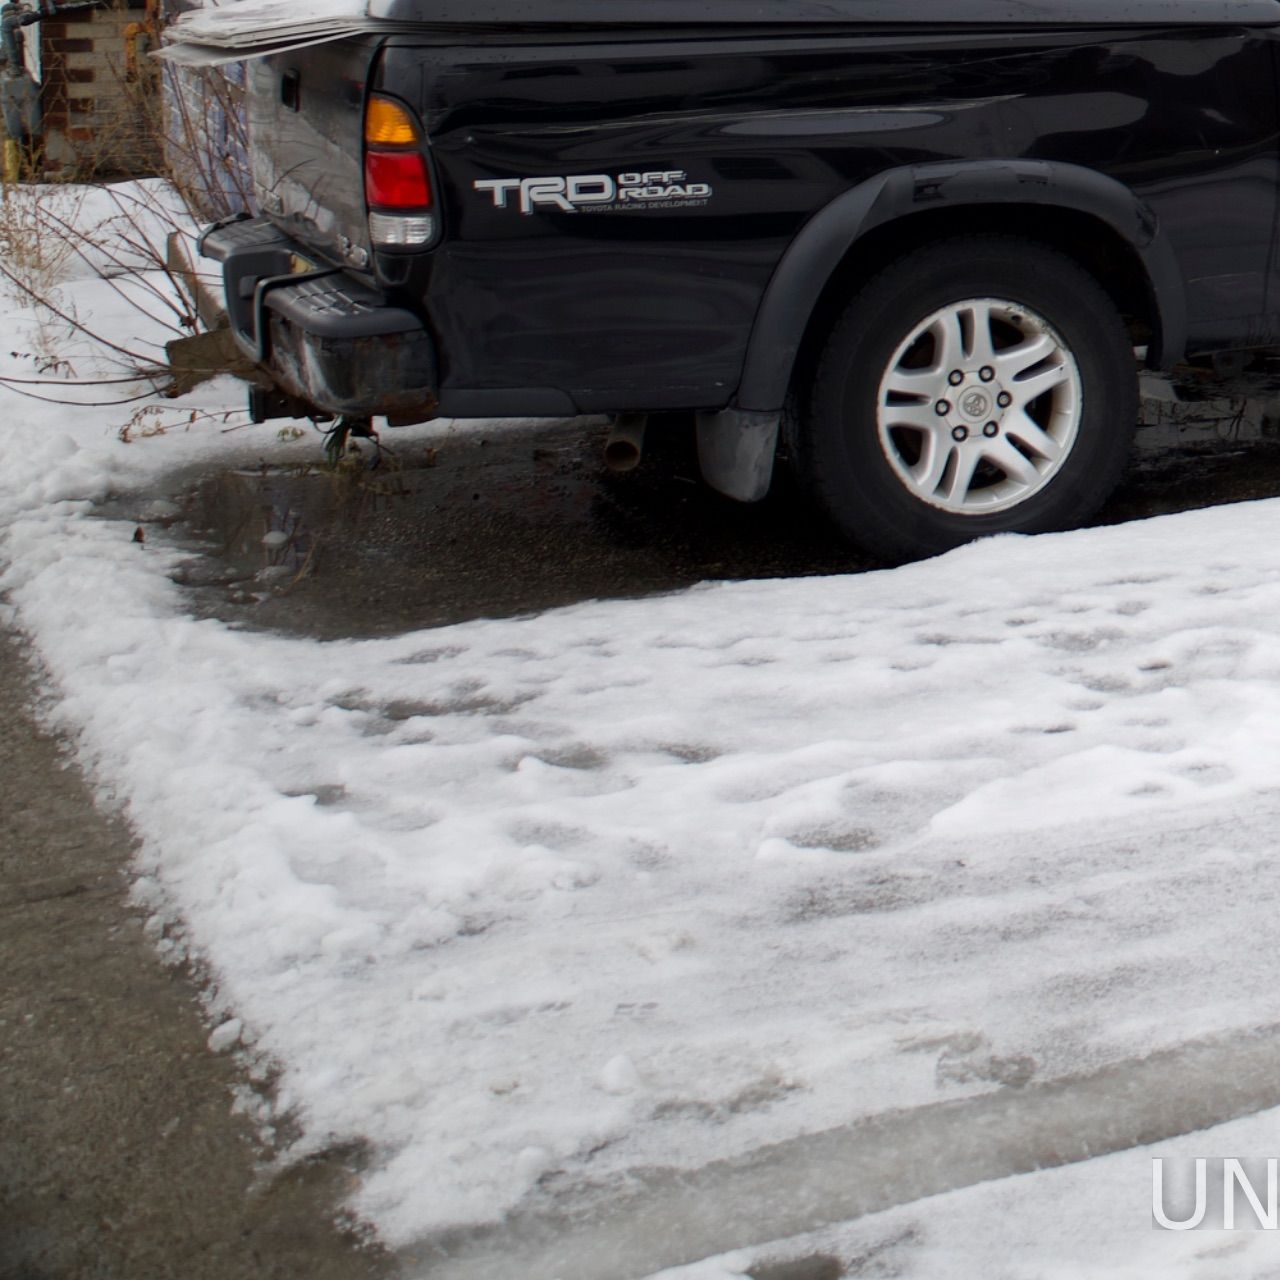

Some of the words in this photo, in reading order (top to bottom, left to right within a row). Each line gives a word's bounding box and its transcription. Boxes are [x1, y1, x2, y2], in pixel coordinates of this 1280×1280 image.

[617, 170, 687, 185] OFF
[474, 174, 617, 215] TRD
[618, 183, 712, 202] ROAD
